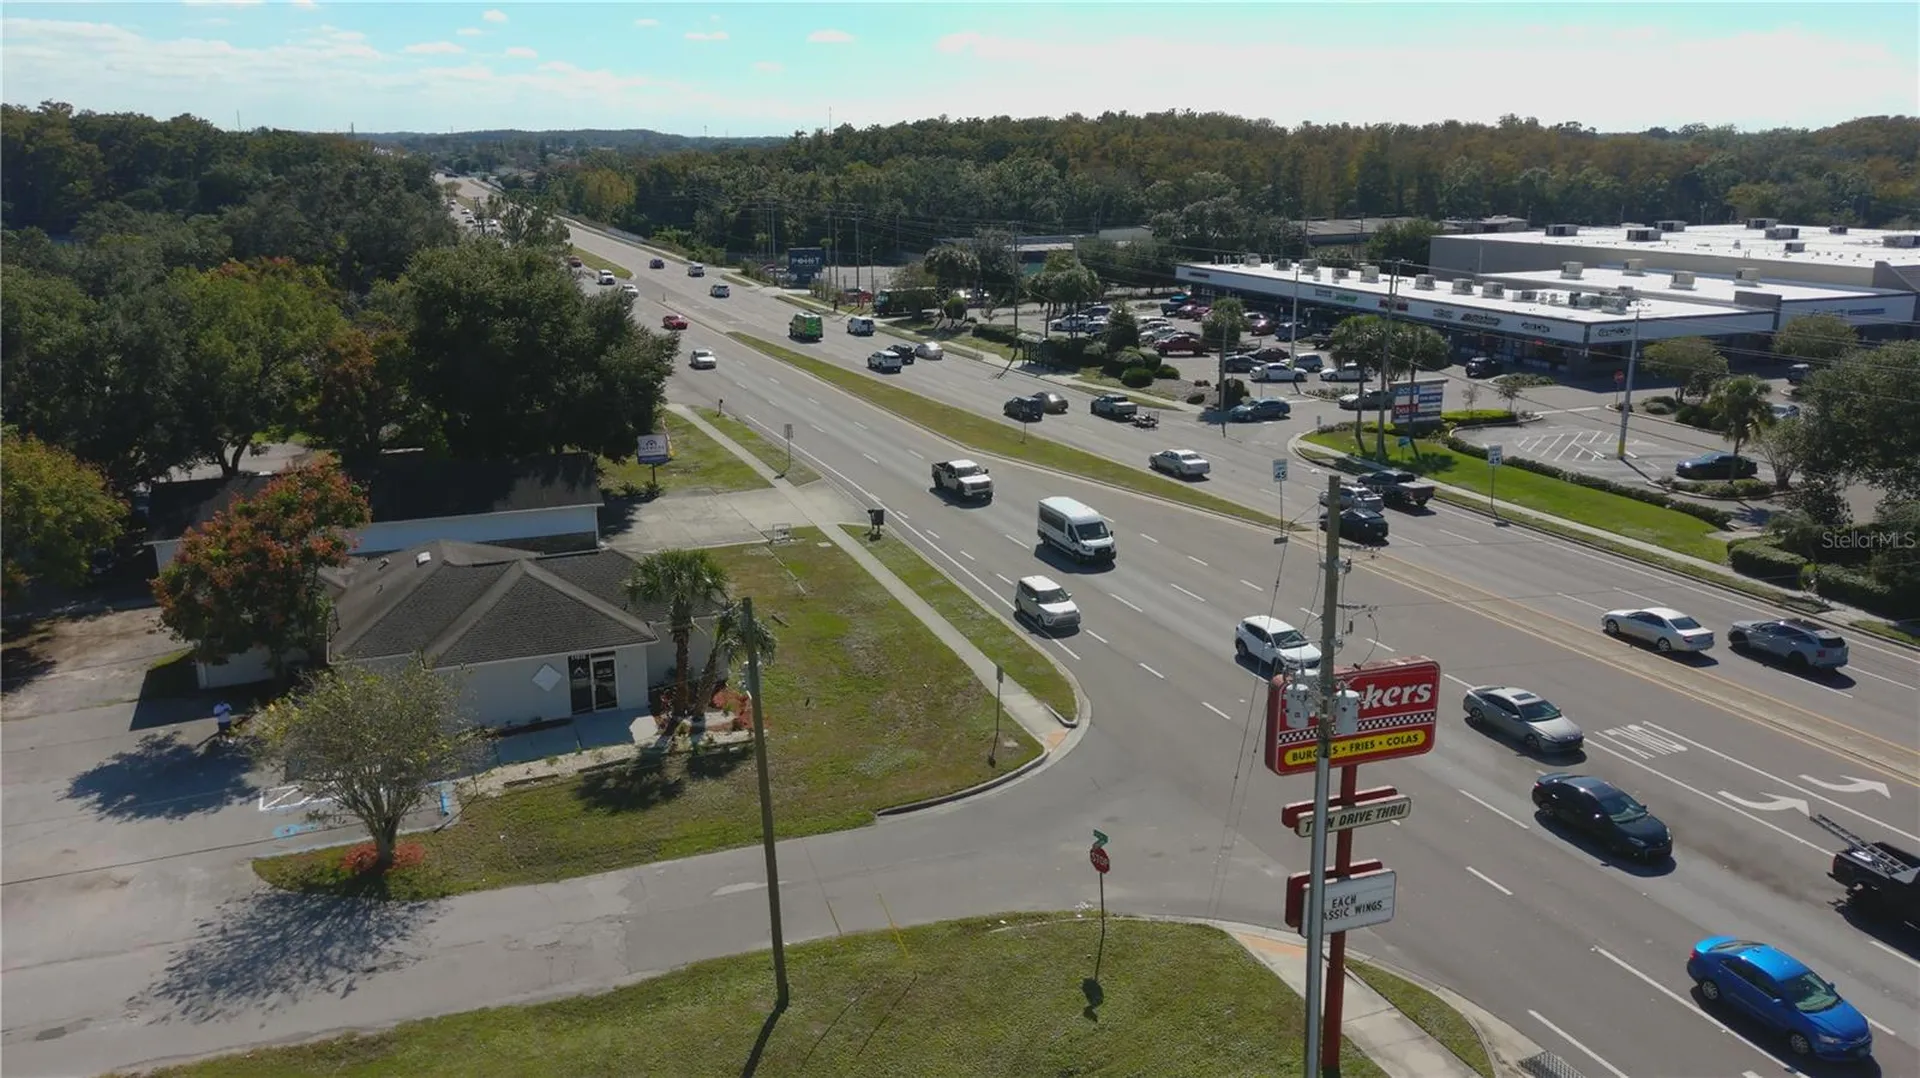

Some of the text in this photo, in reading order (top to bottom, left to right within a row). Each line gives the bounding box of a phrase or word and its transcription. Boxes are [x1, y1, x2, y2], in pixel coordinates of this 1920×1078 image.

[1275, 470, 1287, 479] 45
[1292, 733, 1418, 761] BURGS FRIES COLAS
[1305, 804, 1406, 832] TN DRIVE THRU
[1321, 900, 1383, 920] ASSIC WINGS
[1332, 894, 1356, 908] EACH
